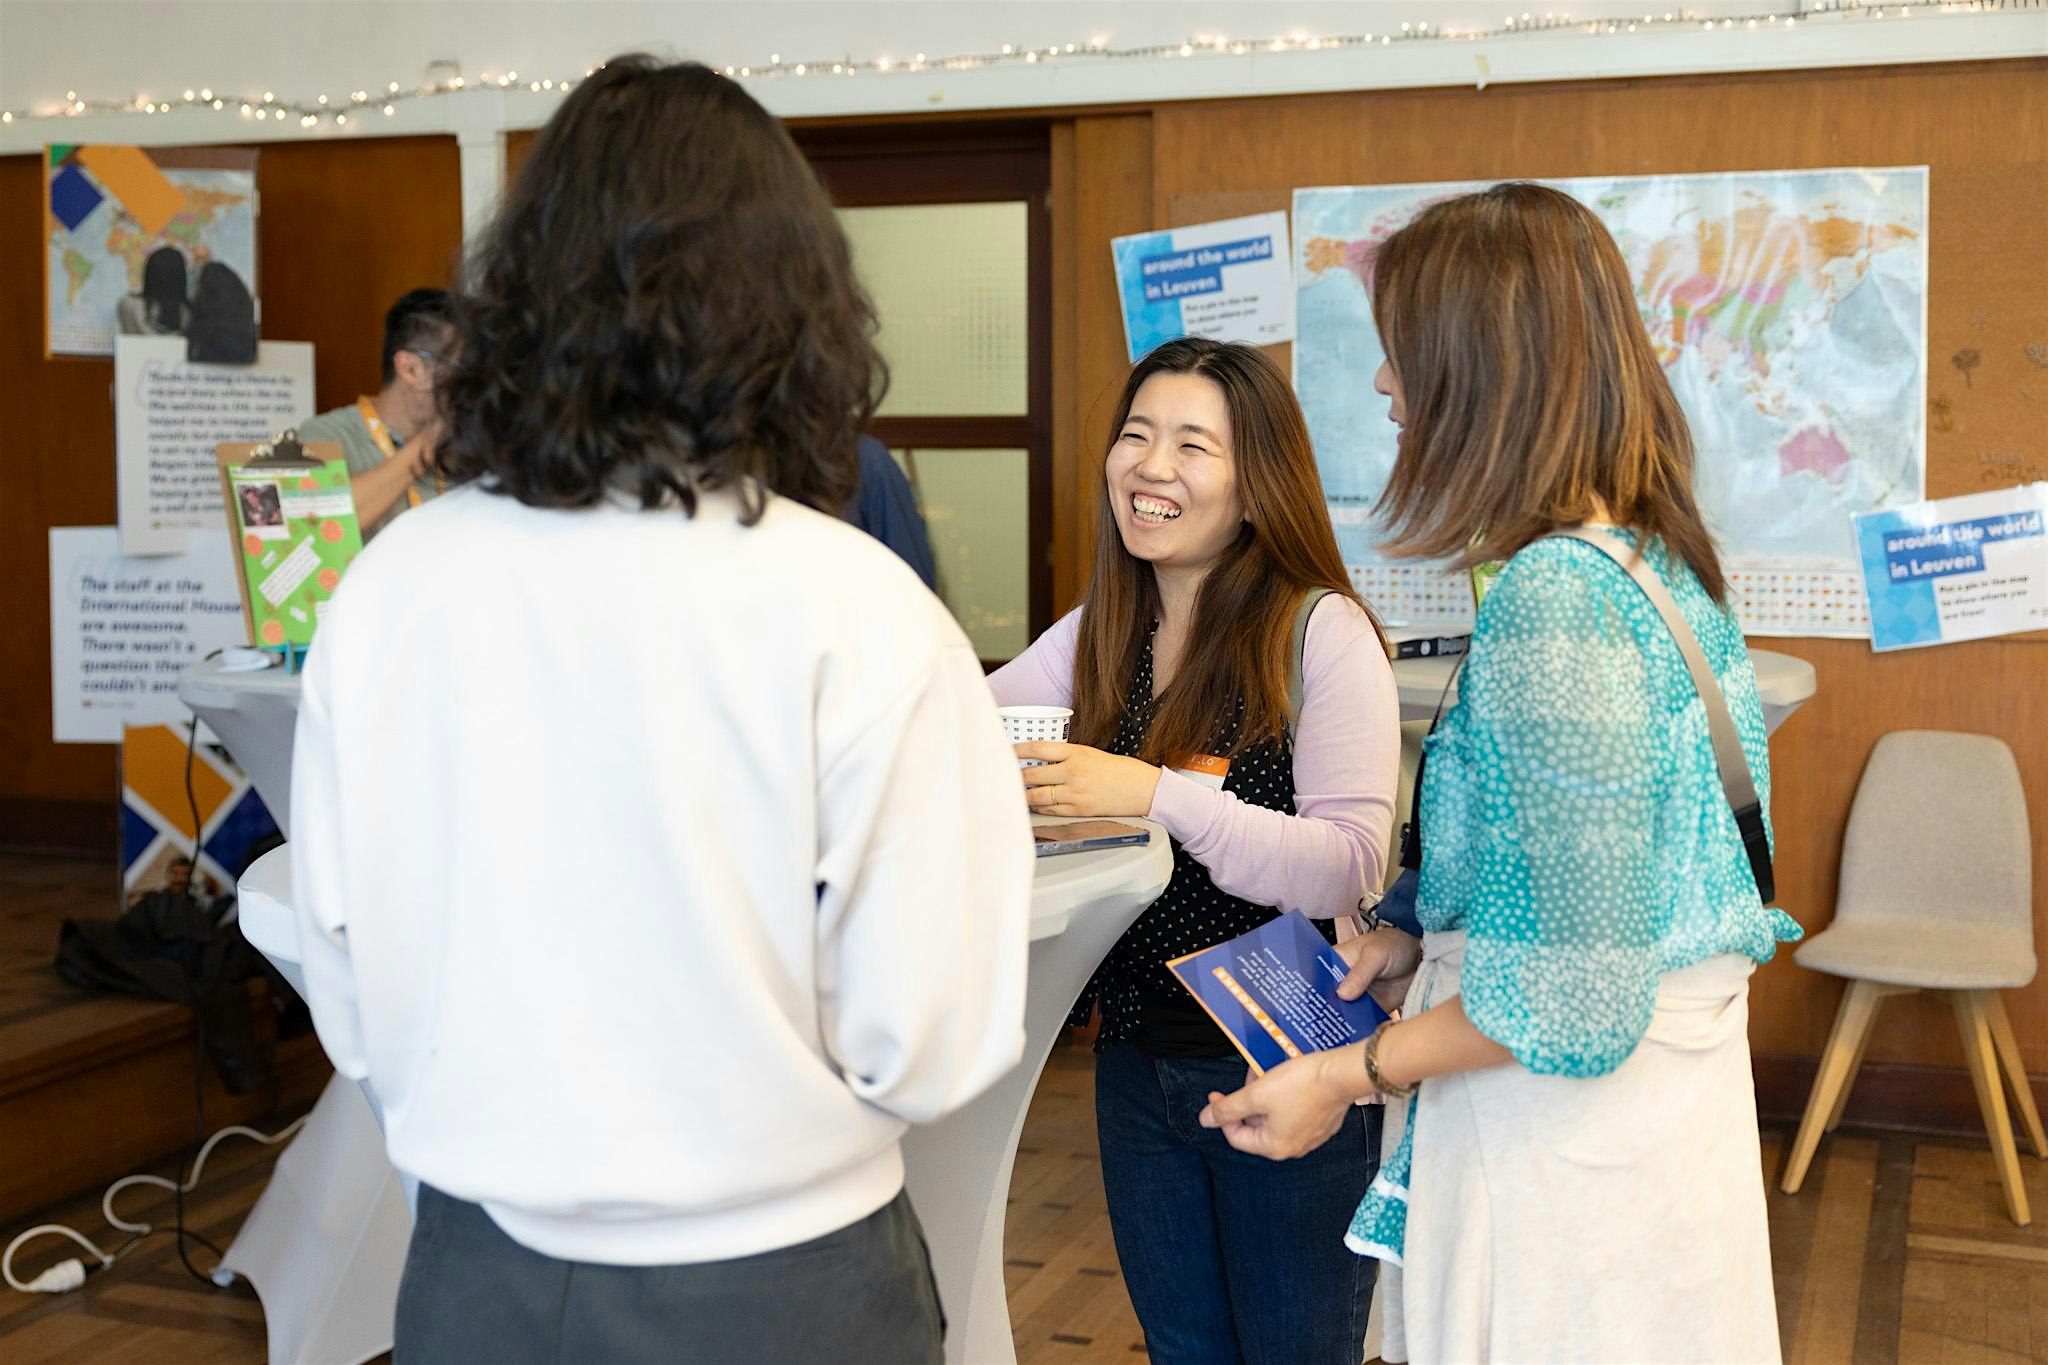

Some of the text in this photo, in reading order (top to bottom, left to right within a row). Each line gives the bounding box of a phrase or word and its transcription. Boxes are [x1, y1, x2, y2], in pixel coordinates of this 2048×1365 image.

[1143, 239, 1271, 275] around the world
[1146, 276, 1217, 299] in Leuven
[1887, 512, 2041, 553] around the world
[1890, 553, 1977, 579] in Leuven
[81, 575, 203, 592] The staff at the
[81, 598, 185, 613] International
[81, 622, 105, 632] are
[82, 637, 126, 652] There
[186, 642, 195, 652] a
[81, 660, 150, 674] question
